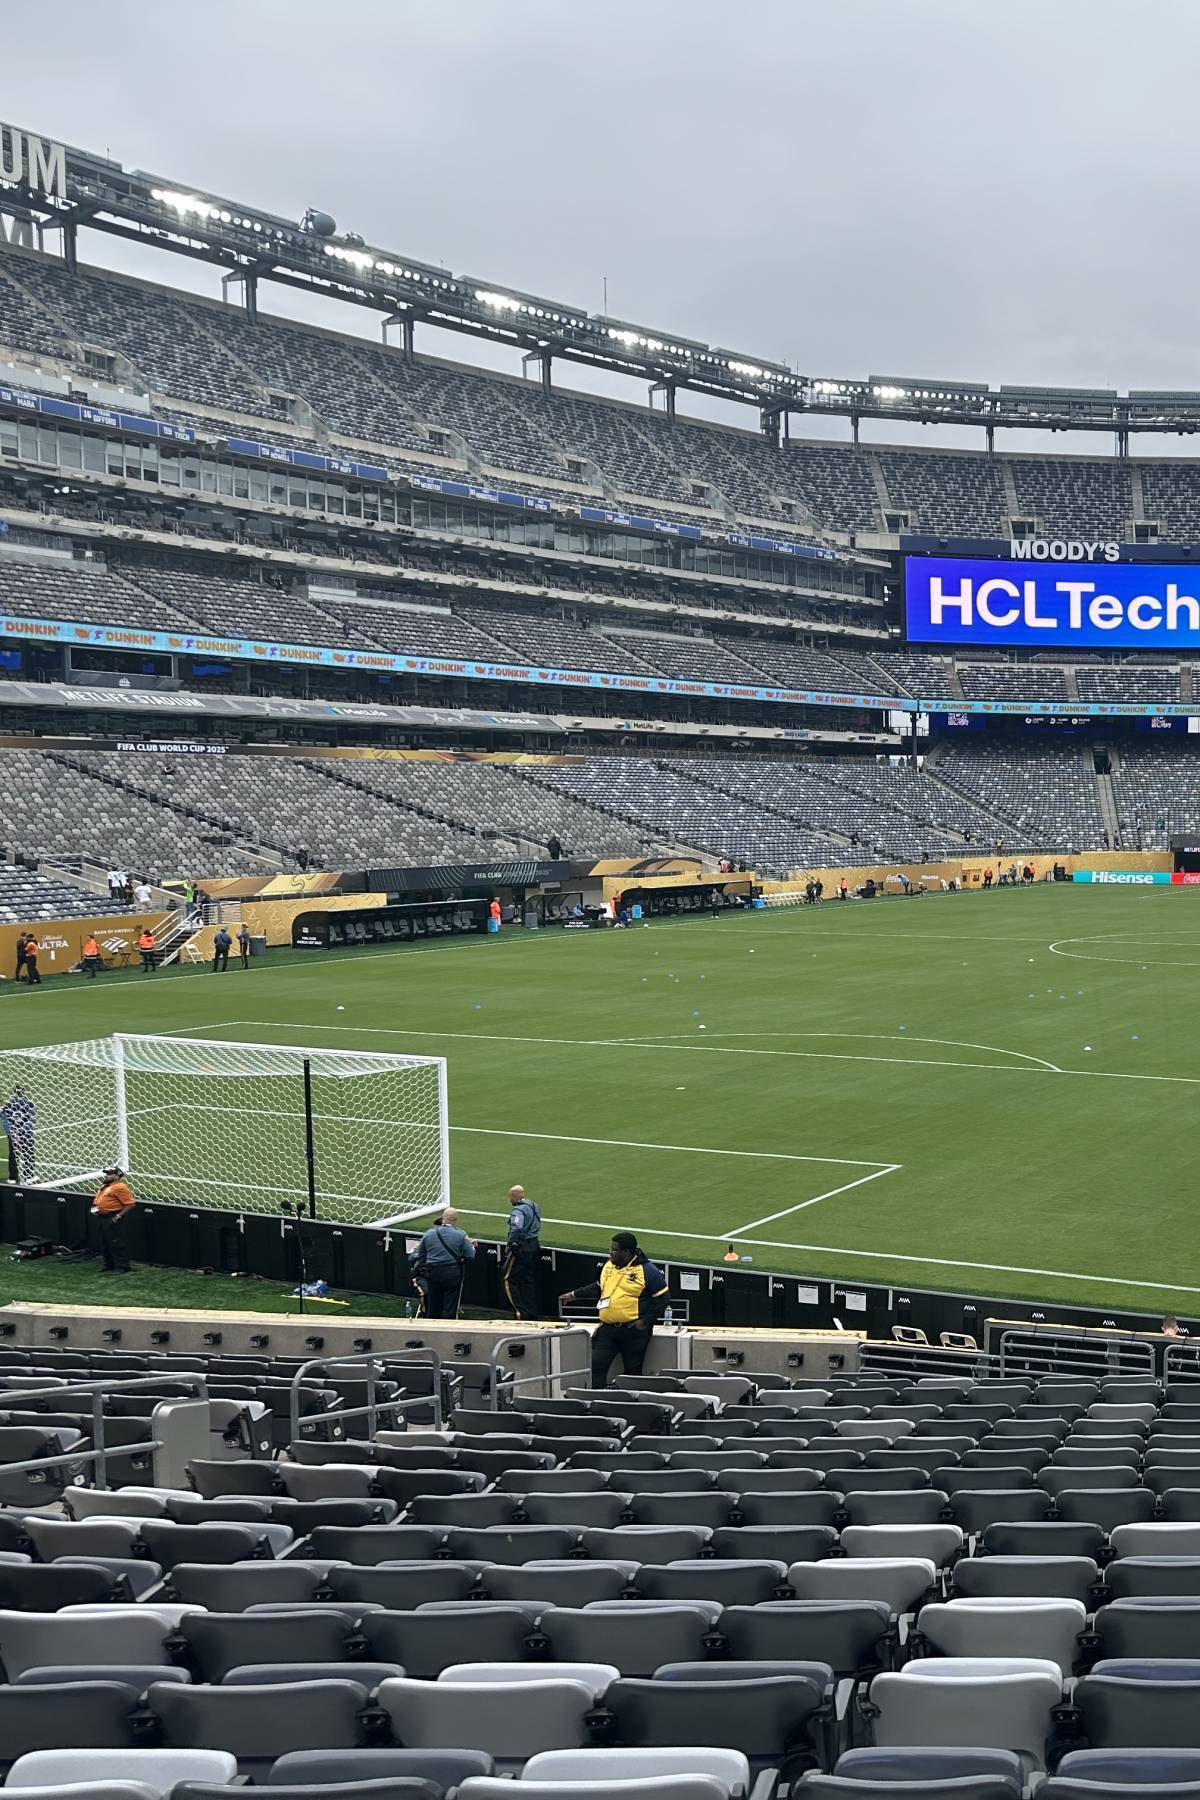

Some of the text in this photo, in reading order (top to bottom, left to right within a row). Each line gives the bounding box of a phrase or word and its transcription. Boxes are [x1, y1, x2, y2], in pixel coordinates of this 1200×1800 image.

[1010, 540, 1120, 562] MOODY'S
[929, 576, 1200, 630] HCLTech
[5, 622, 61, 636] DUNKIN'
[105, 631, 156, 646] DUNKIN'
[196, 639, 242, 653] DUNKIN'
[280, 648, 322, 660] DUNKIN'
[357, 655, 396, 667] DUNKIN'
[428, 662, 466, 673] DUNKIN'
[495, 667, 531, 678] DUNKIN'
[558, 673, 592, 684] DUNKIN'
[619, 678, 651, 688] DUNKIN'
[59, 690, 206, 708] METLIFE STADIUM
[117, 743, 135, 752] FIFA
[136, 743, 158, 752] CLUB
[159, 744, 188, 753] WORLD
[190, 744, 205, 753] CUP
[1092, 871, 1153, 884] Hisense
[37, 940, 69, 950] ULTRA
